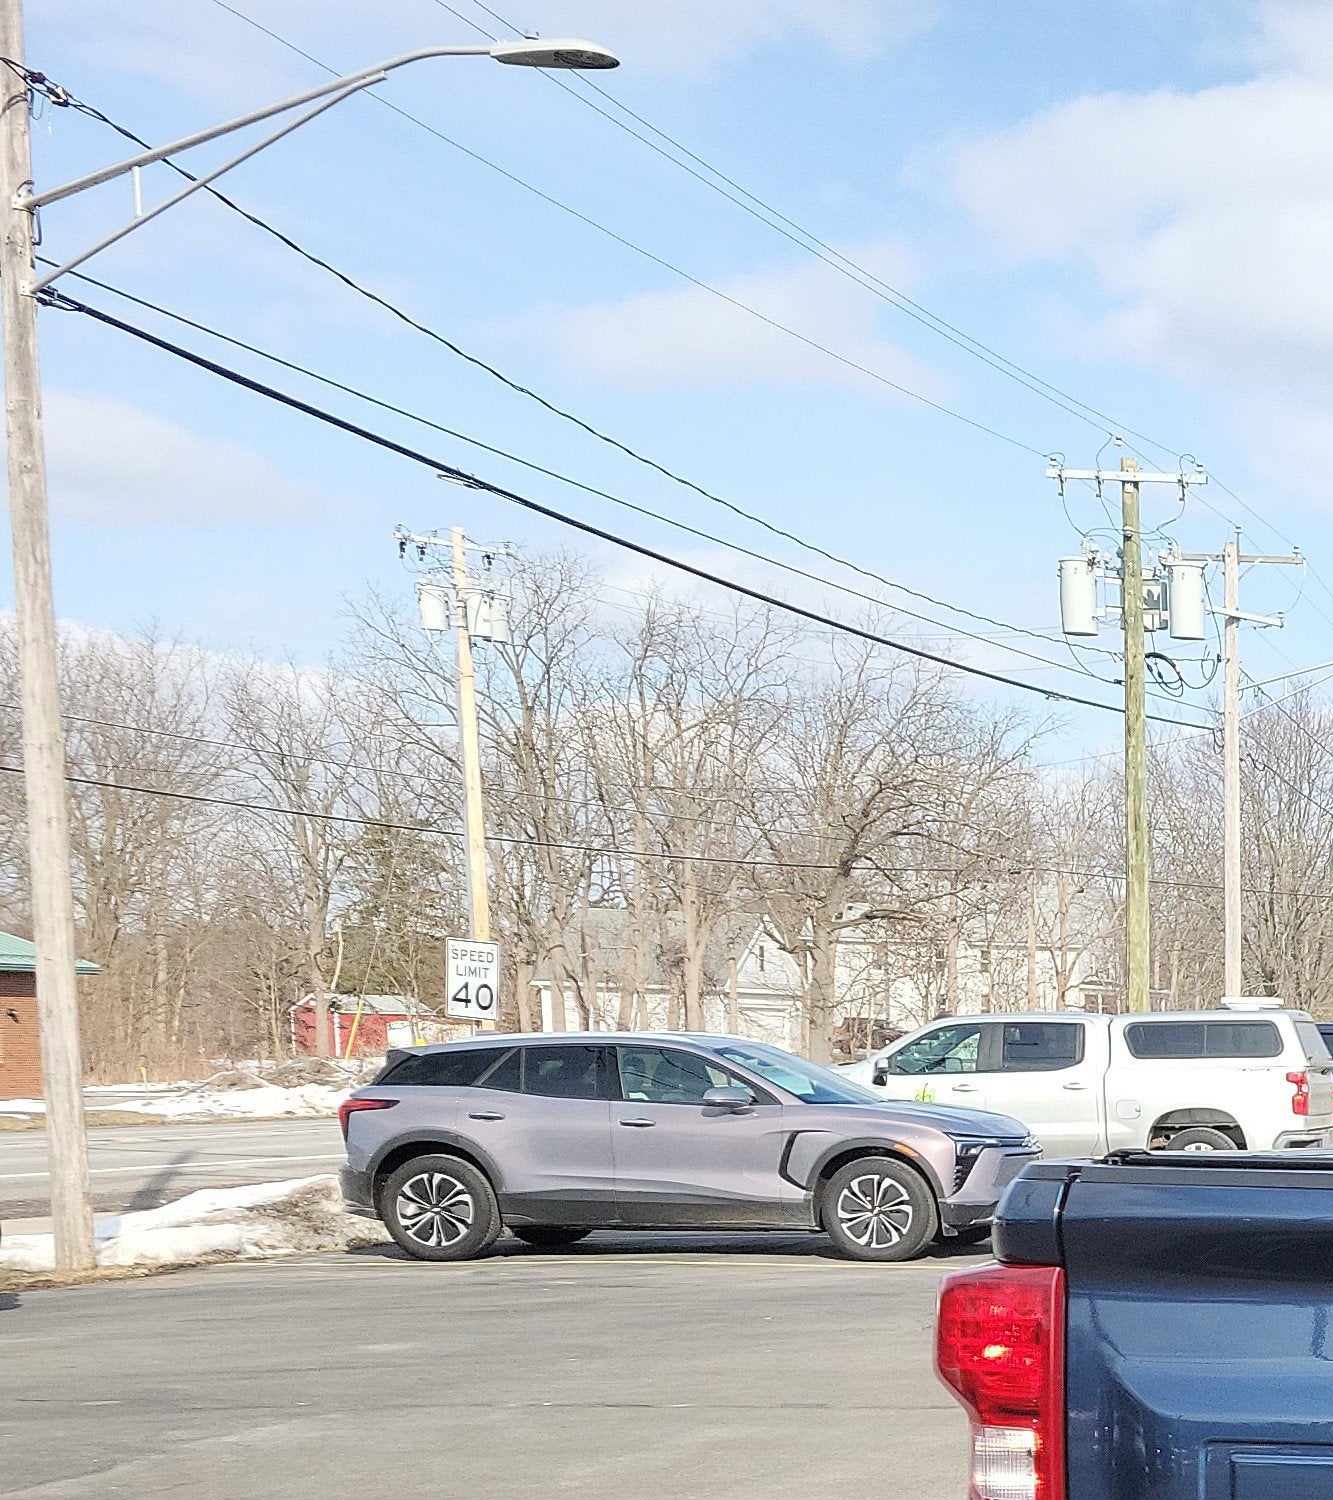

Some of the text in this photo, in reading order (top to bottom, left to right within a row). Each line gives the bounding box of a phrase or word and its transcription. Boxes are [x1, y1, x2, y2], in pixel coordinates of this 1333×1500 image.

[451, 948, 494, 963] SPEED
[456, 965, 490, 978] LIMIT
[451, 982, 493, 1010] 40
